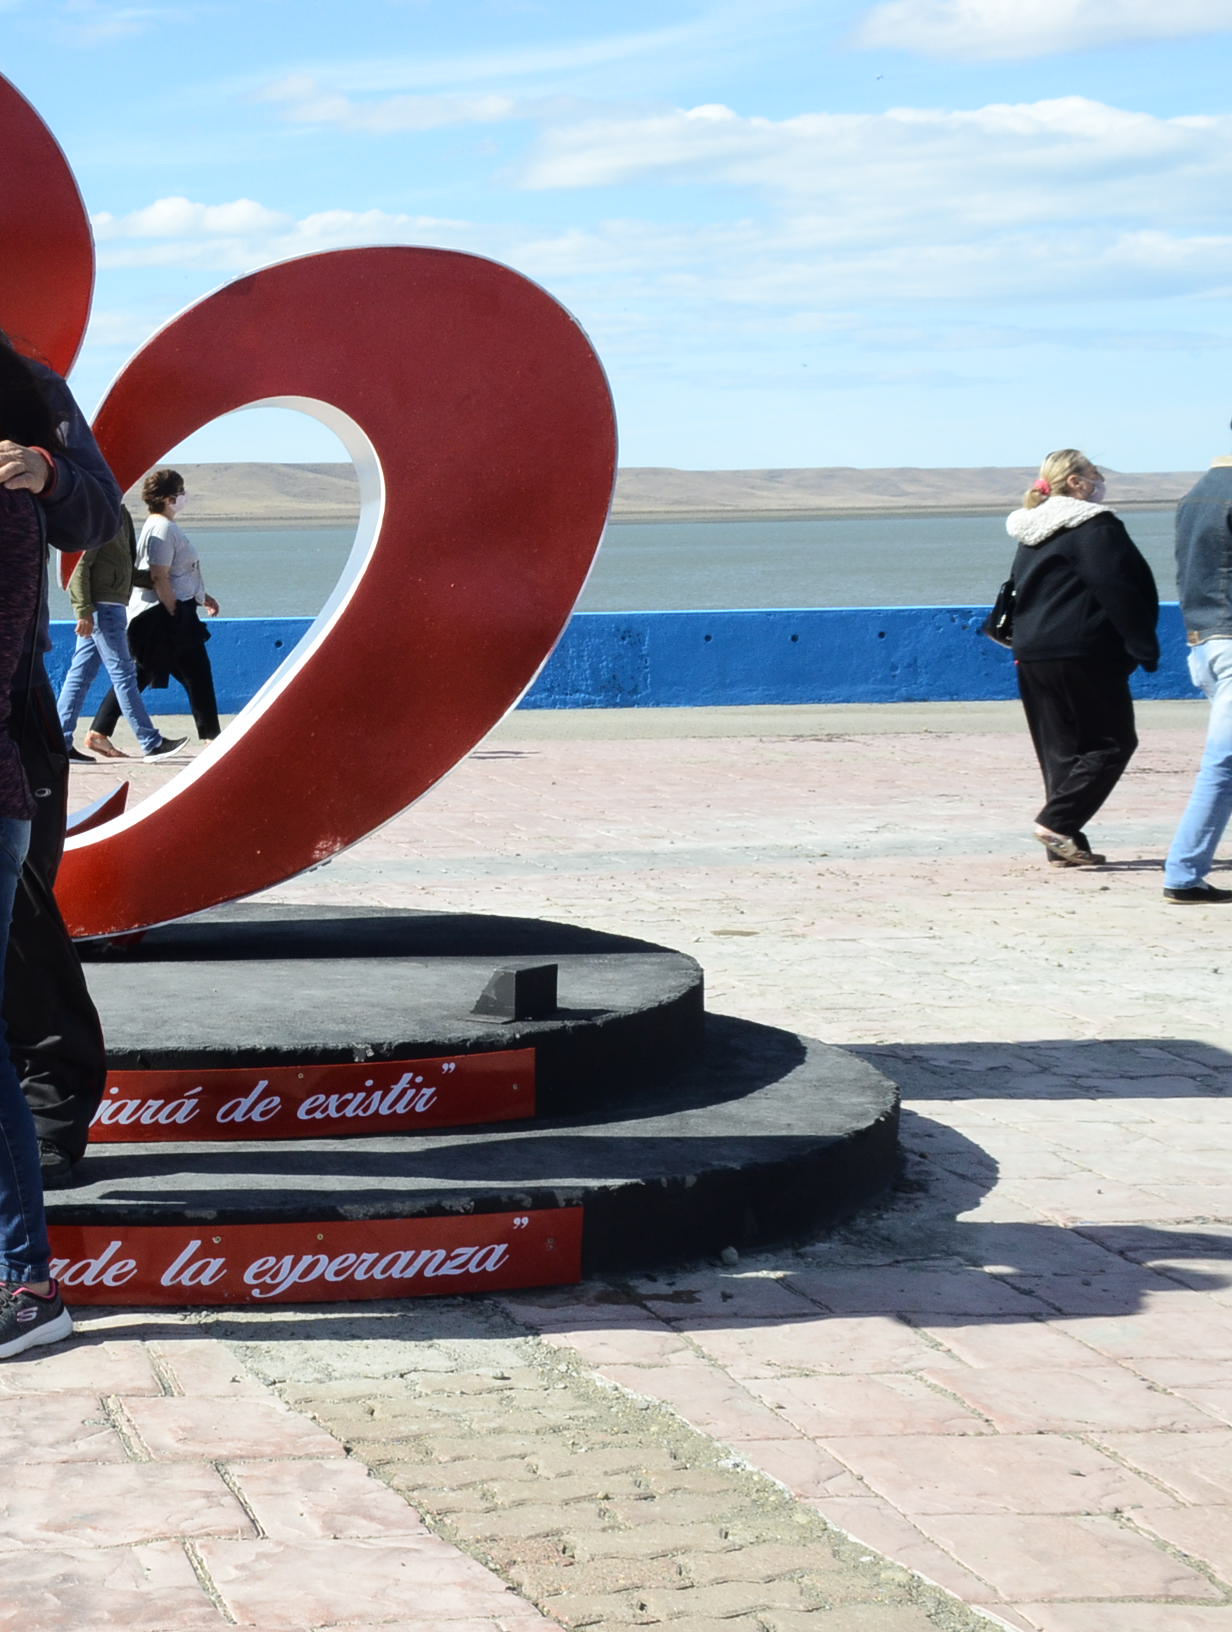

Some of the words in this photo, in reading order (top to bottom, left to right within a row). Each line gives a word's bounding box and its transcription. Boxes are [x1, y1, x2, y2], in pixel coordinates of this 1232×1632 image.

[88, 1086, 203, 1128] jará
[216, 1079, 282, 1123] de
[296, 1062, 456, 1120] existir”
[49, 1240, 138, 1287] rde
[159, 1239, 227, 1287] la
